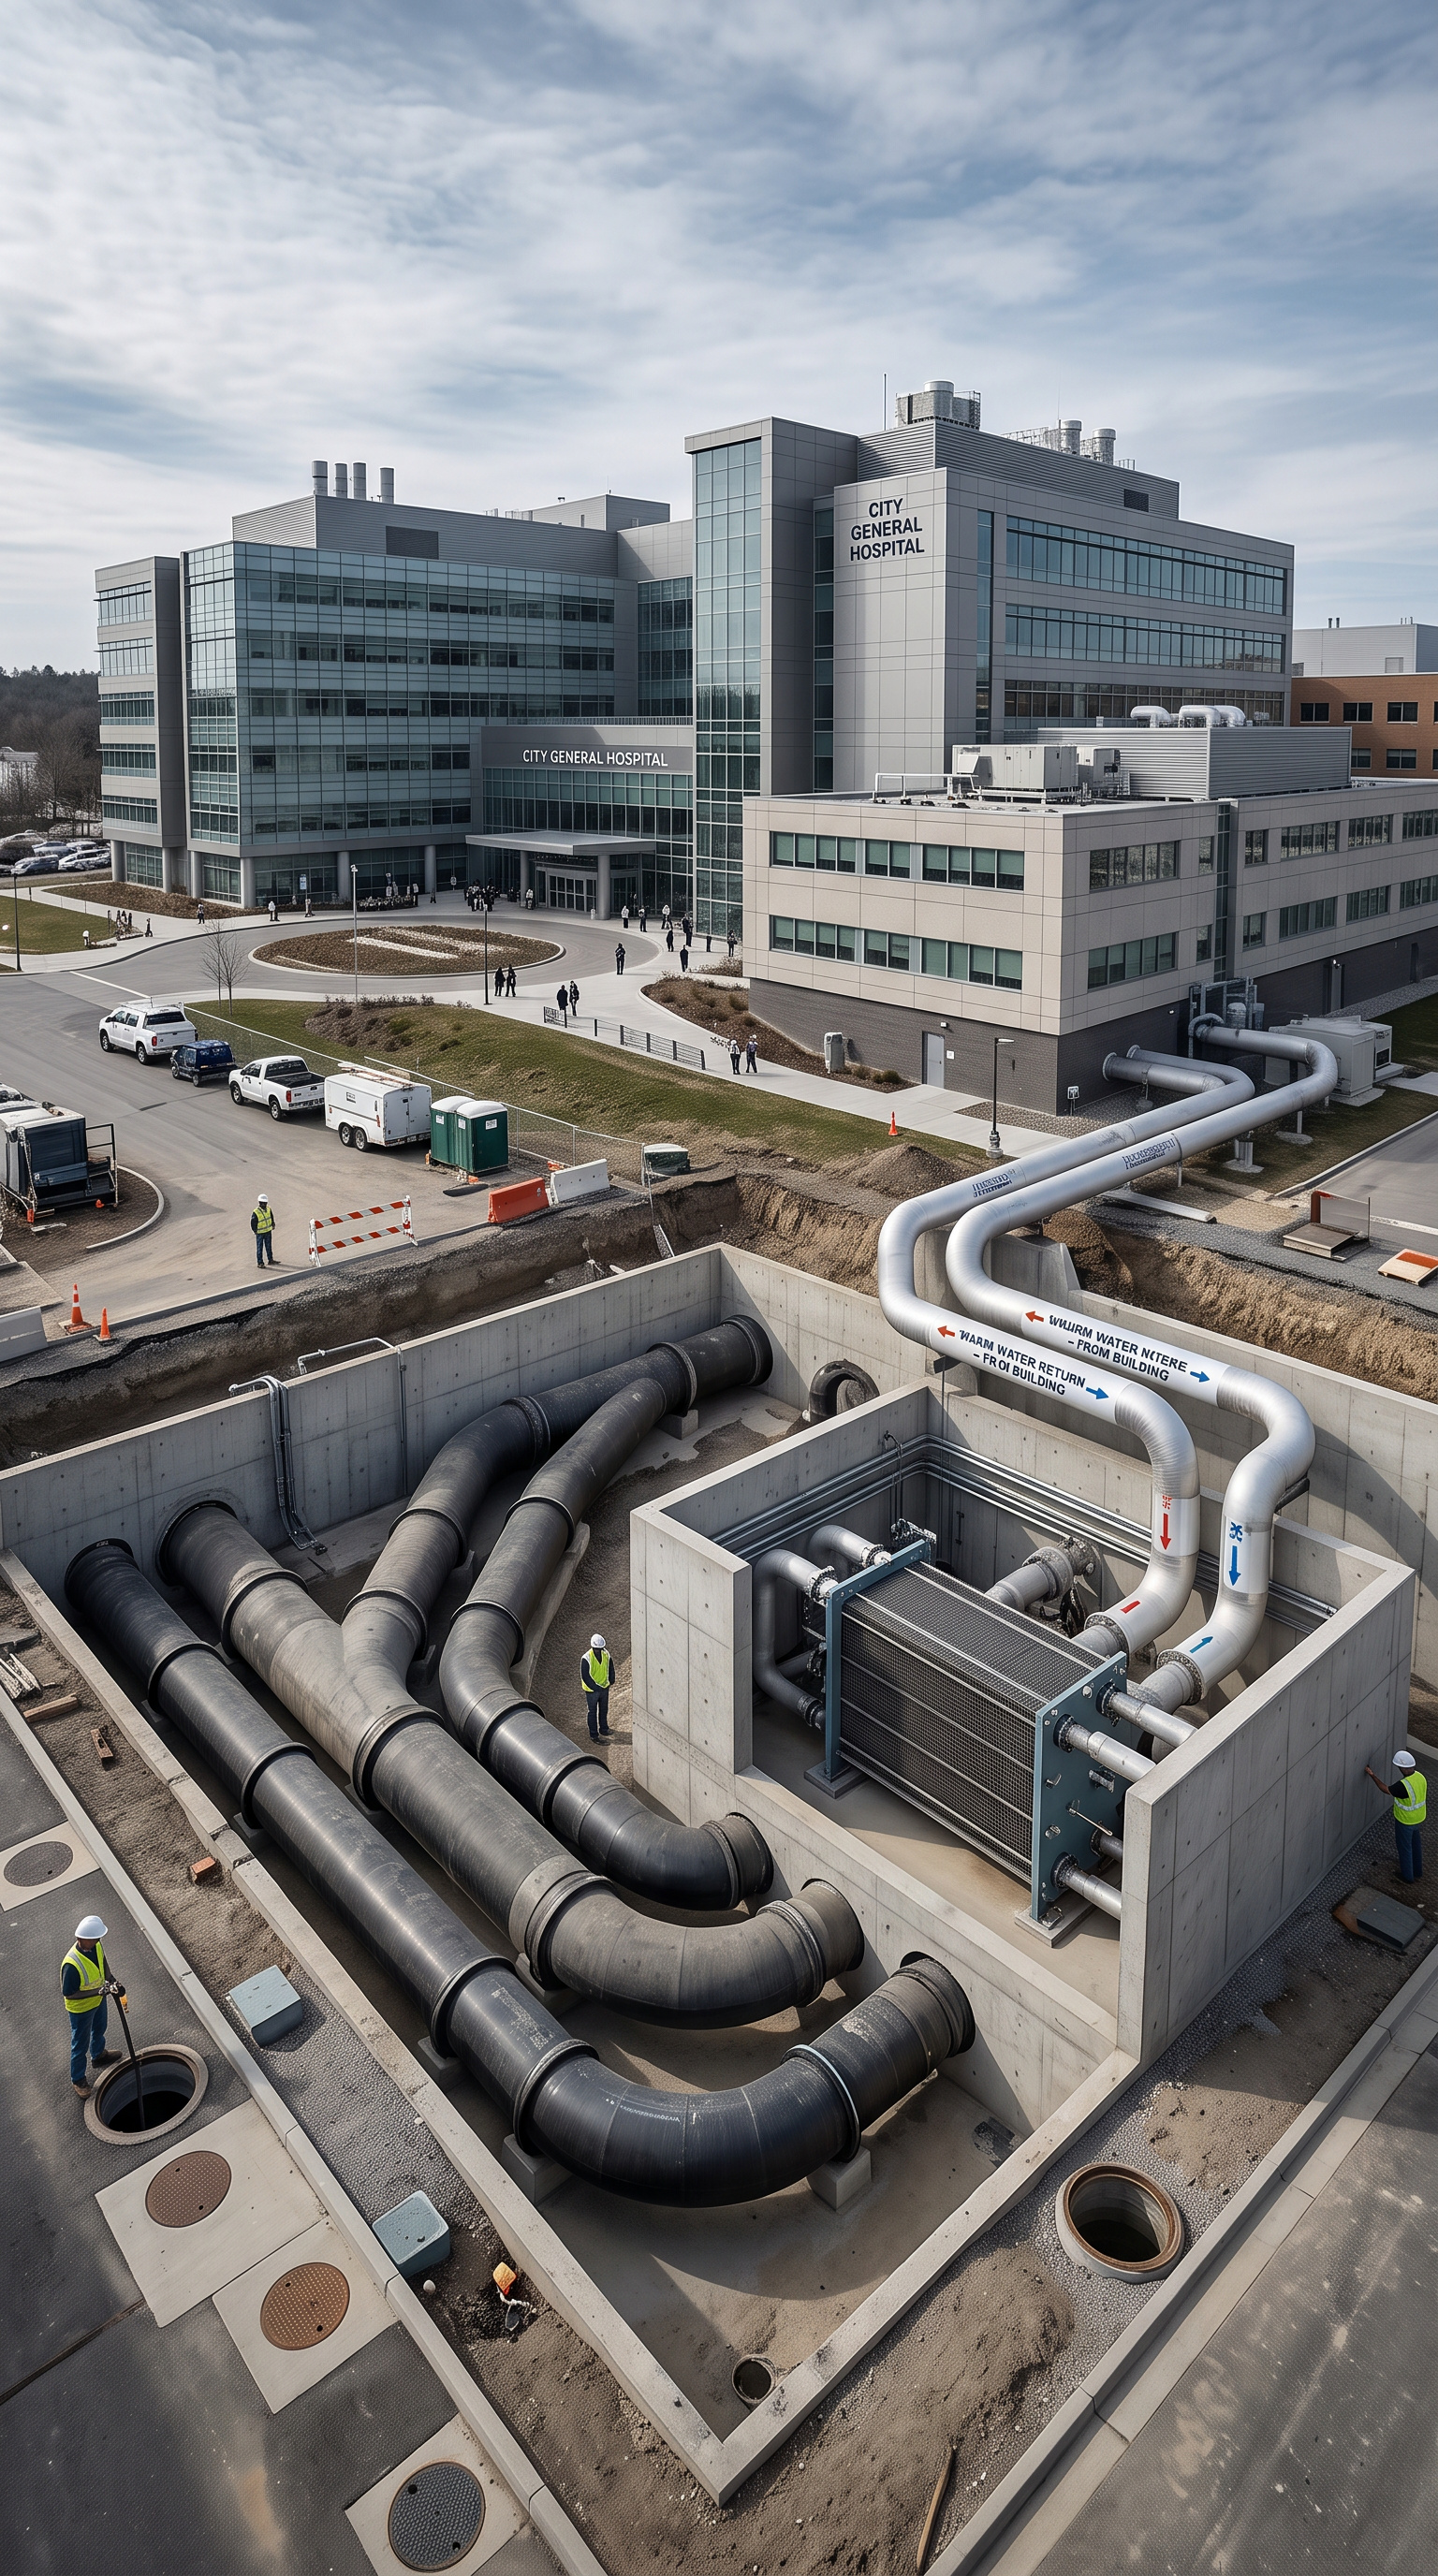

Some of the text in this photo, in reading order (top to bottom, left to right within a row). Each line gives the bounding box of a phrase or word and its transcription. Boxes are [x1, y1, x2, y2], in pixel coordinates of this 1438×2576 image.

[869, 498, 903, 518] CITY
[851, 517, 922, 540] GENERAL
[850, 537, 925, 561] HOSPITAL
[522, 749, 668, 767] CITY GENERAL HOSPITAL
[1096, 1331, 1138, 1355] WATER
[997, 1343, 1036, 1369] WATER
[1038, 1363, 1086, 1388] RETURN
[1077, 1339, 1110, 1360] FROM
[1113, 1352, 1169, 1382] BUILDING
[1012, 1366, 1065, 1396] BUILDING
